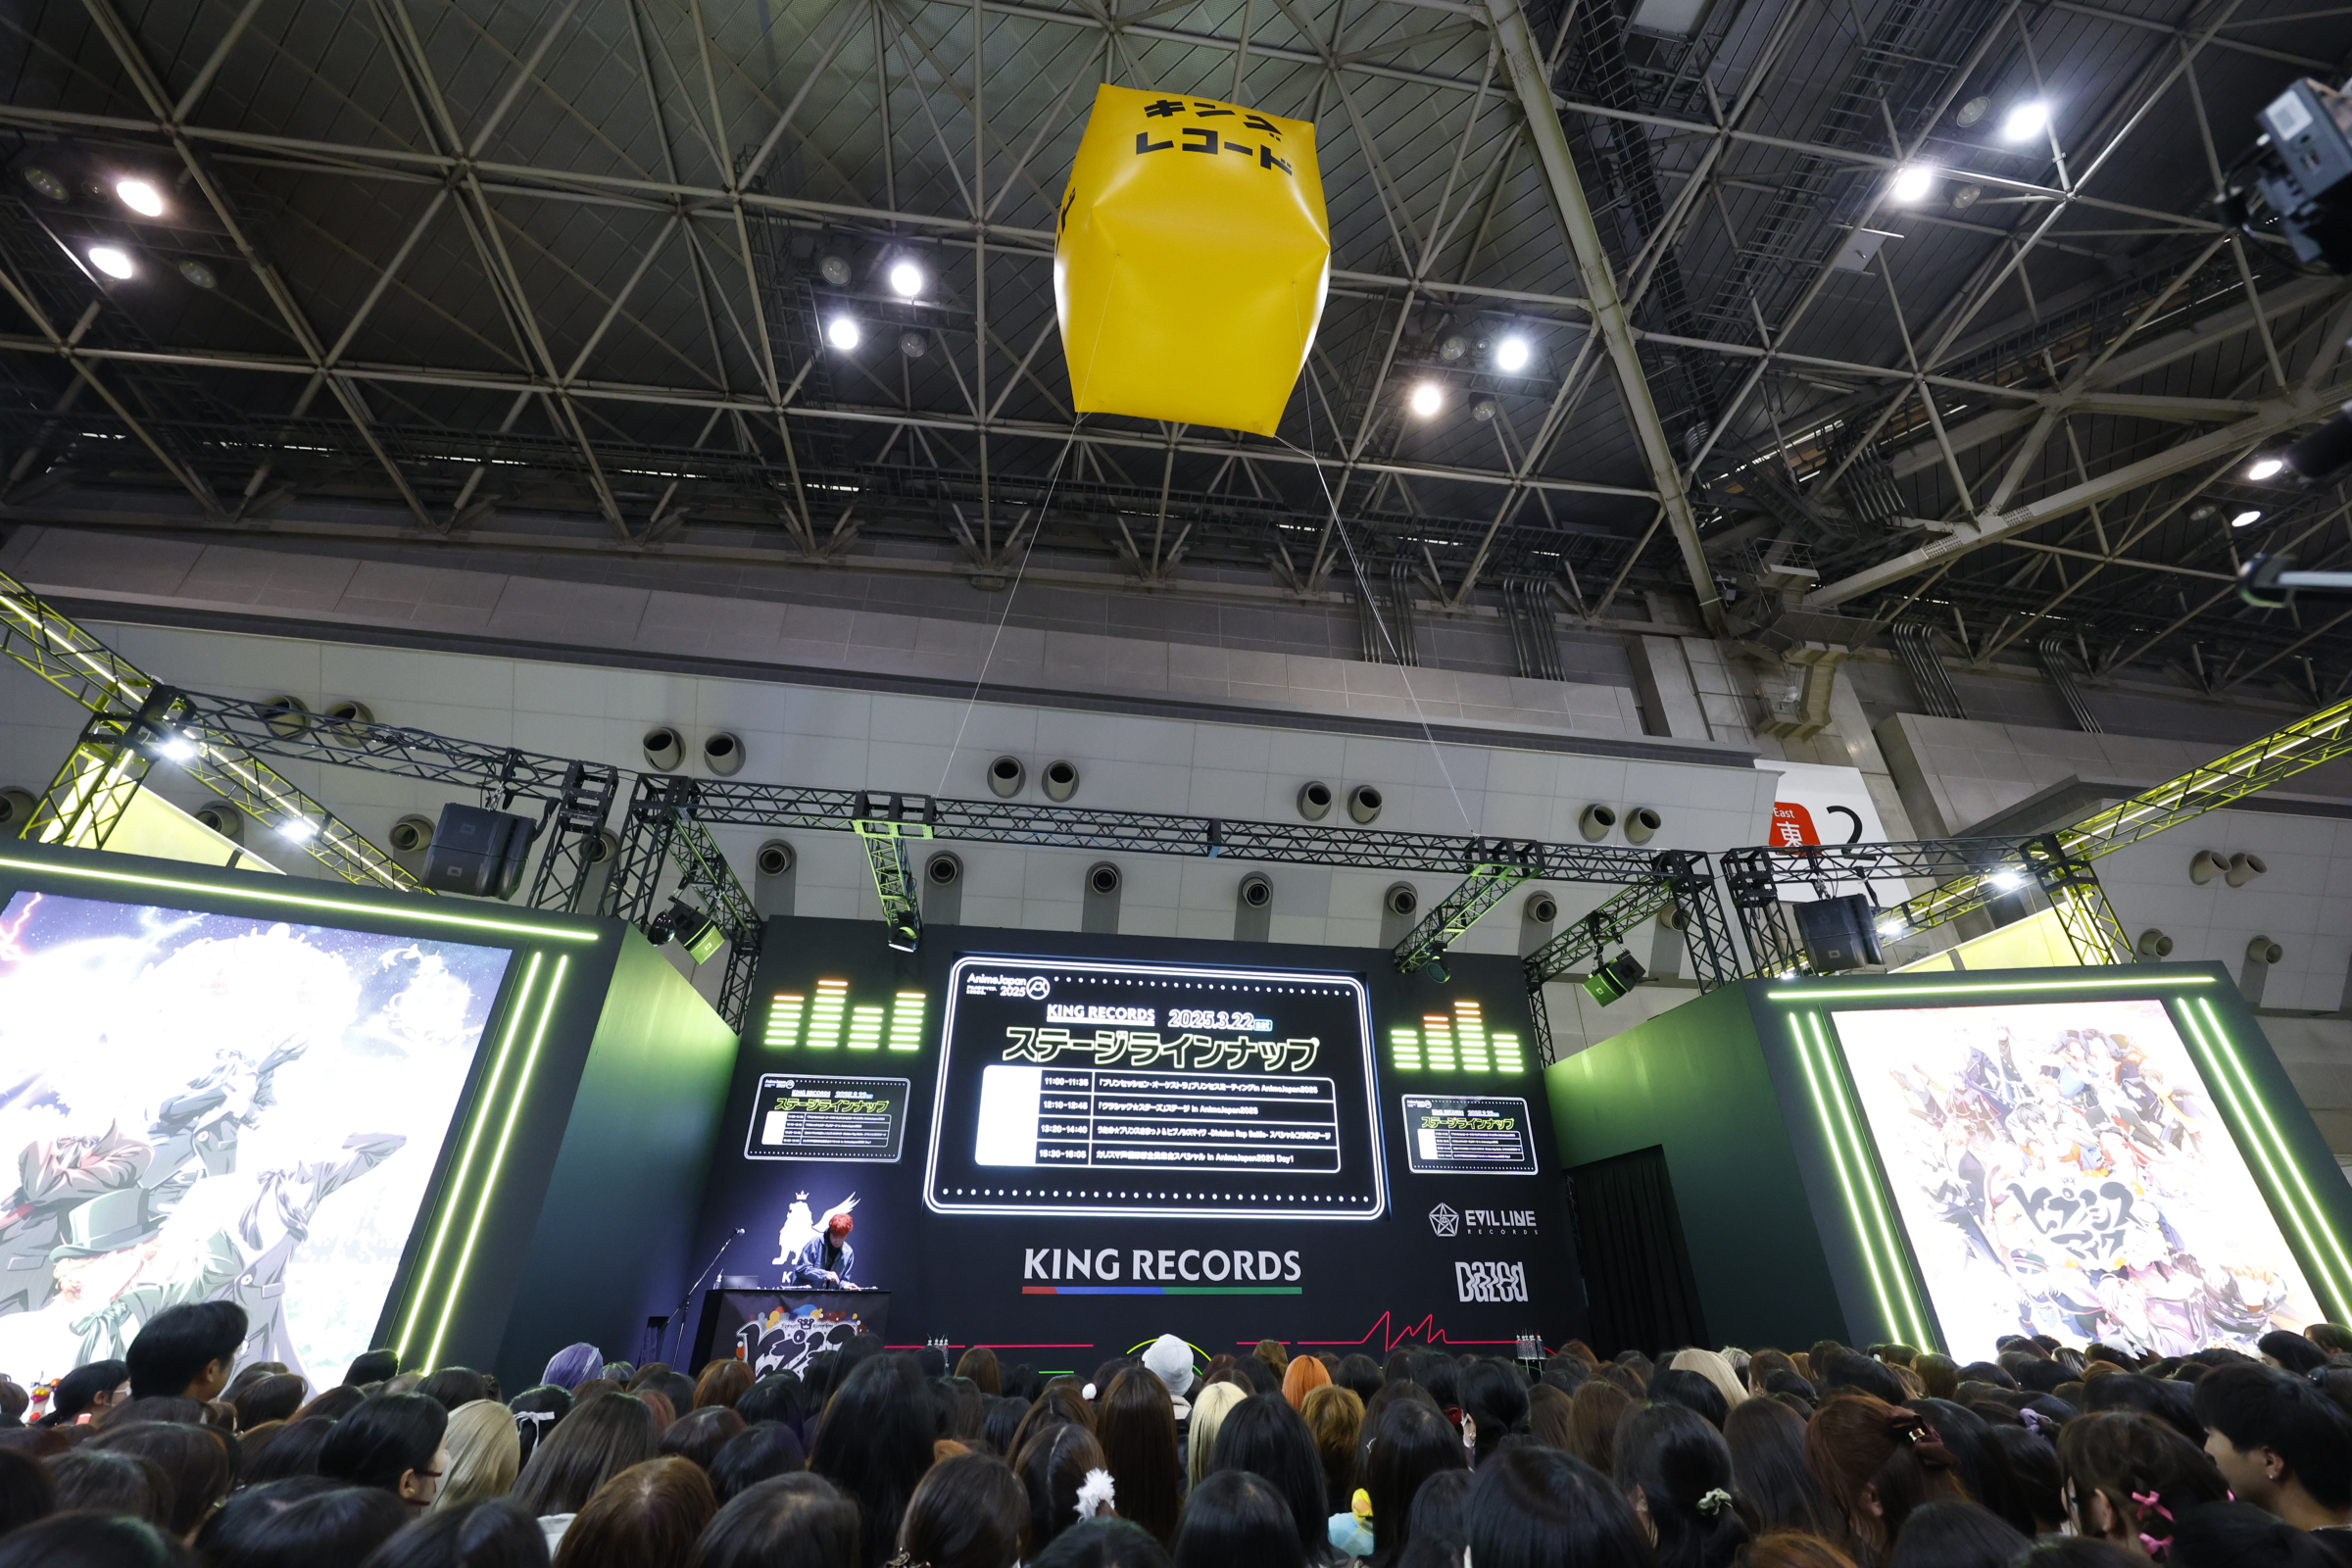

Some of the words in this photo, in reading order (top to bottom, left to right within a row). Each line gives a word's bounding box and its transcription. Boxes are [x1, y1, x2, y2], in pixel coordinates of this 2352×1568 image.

[1144, 99, 1284, 142] キング
[1136, 128, 1293, 175] レコード
[1773, 807, 1795, 819] East
[1776, 820, 1803, 848] 東
[1826, 805, 1878, 861] 2
[1000, 985, 1026, 997] 2025
[1047, 1004, 1085, 1018] KING
[1089, 1005, 1155, 1021] RECORDS
[1002, 1026, 1320, 1072] ステージラインナップ
[774, 1098, 890, 1113] ステージラインナップ
[1421, 1116, 1515, 1130] ステージラインナップ
[1464, 1209, 1500, 1227] EVIL
[1500, 1209, 1538, 1227] LINE
[1023, 1249, 1120, 1281] KING
[1132, 1250, 1302, 1282] RECORDS
